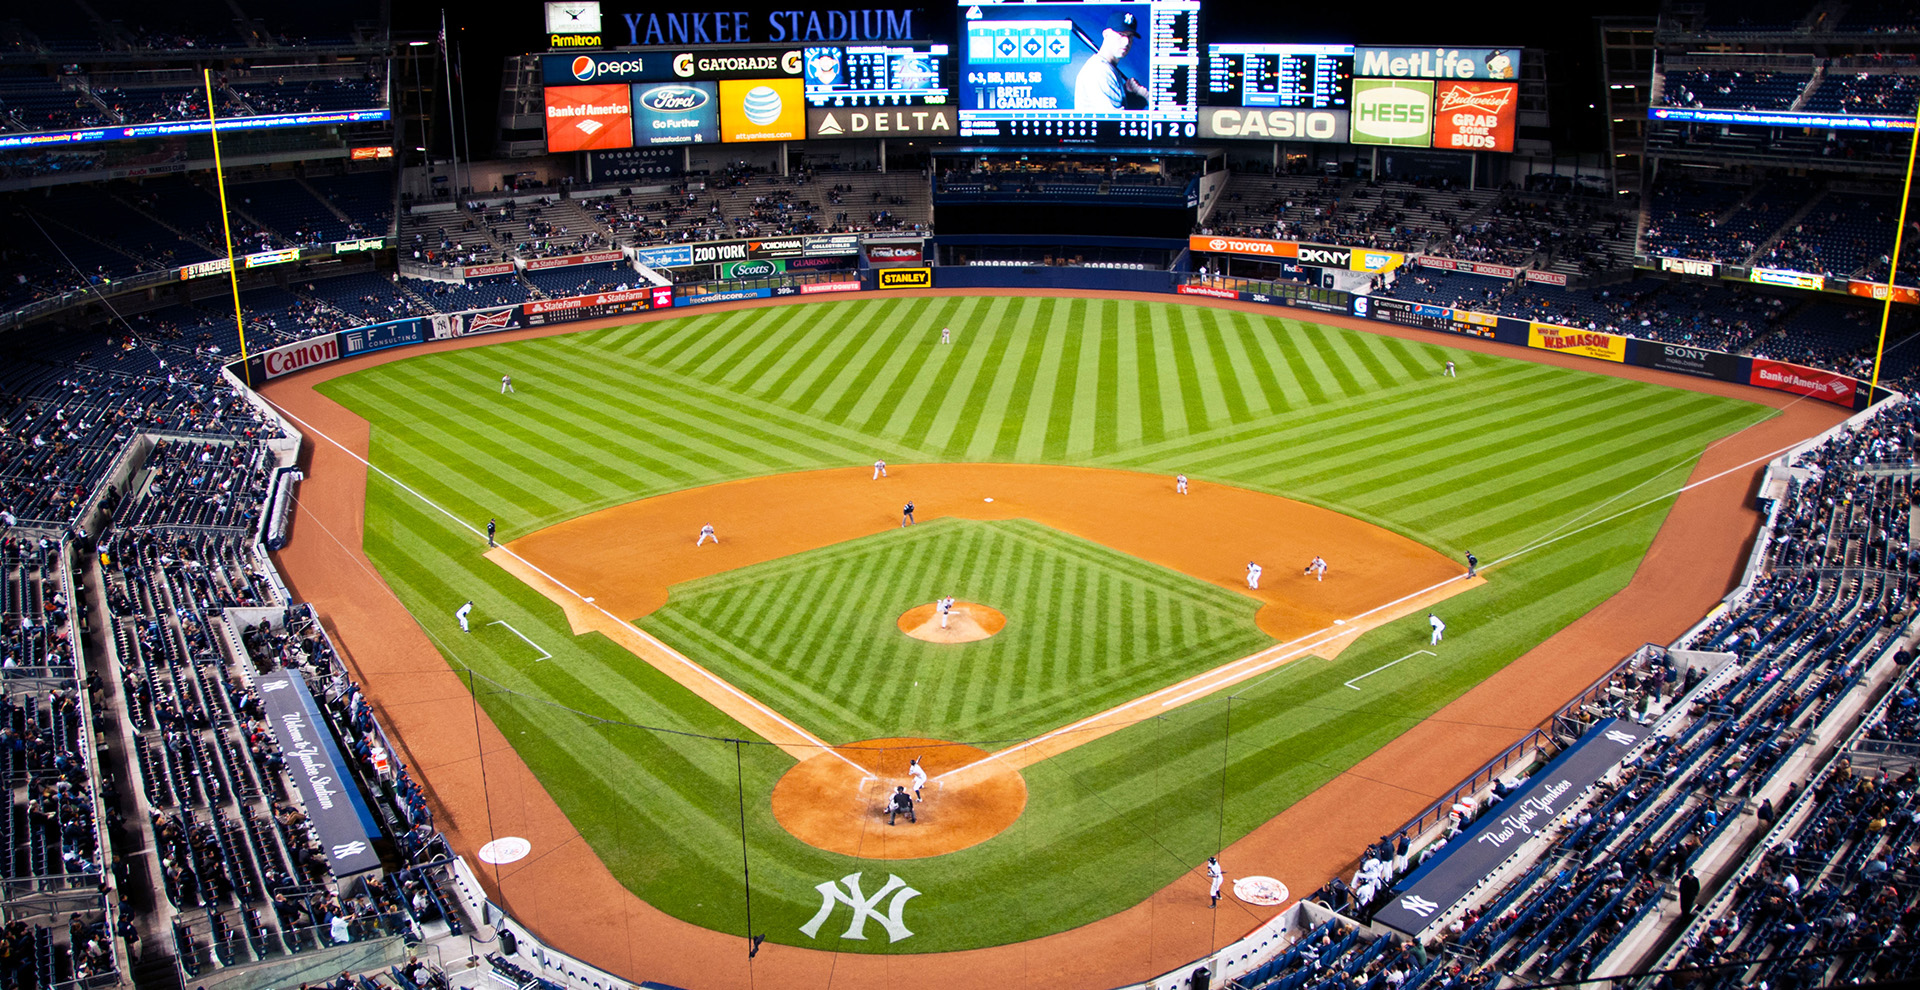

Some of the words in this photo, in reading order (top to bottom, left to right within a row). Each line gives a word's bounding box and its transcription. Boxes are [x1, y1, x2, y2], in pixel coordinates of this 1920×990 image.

[623, 12, 750, 45] YANKEE
[769, 9, 913, 42] STADIUM
[551, 33, 602, 47] Armitron
[598, 58, 643, 76] pepsi
[673, 53, 694, 77] G
[699, 57, 777, 71] GATORADE
[781, 51, 802, 74] G
[1362, 48, 1475, 78] MetLife
[653, 89, 696, 108] Ford
[975, 87, 996, 110] 11
[997, 86, 1032, 98] BRETT
[997, 97, 1057, 109] GARDNER
[1440, 92, 1509, 106] Budweiser
[548, 105, 576, 117] Bank
[574, 104, 586, 116] of
[586, 102, 628, 115] America
[1361, 103, 1425, 123] HESS
[652, 120, 666, 129] Go
[667, 118, 699, 128] Further
[851, 112, 950, 132] DELTA
[1211, 109, 1335, 138] CASIO
[1452, 114, 1498, 127] GRAB
[735, 131, 792, 140] att.yankees.com
[1154, 122, 1162, 137] 1
[1169, 122, 1179, 137] 2
[1184, 122, 1196, 137] 0
[1459, 126, 1489, 135] SOME
[1451, 134, 1496, 148] BUDS
[761, 240, 802, 250] YOKOHAMA
[1228, 241, 1274, 253] TOYOTA
[695, 247, 716, 261] ZOO
[717, 244, 746, 259] YORK
[1298, 248, 1350, 265] DKNY
[188, 260, 231, 275] SYRACUSE
[1283, 263, 1303, 272] FedEx
[1366, 255, 1386, 267] SAP
[1420, 258, 1453, 268] MODELL'S
[737, 264, 769, 276] Scotts
[1476, 266, 1511, 276] MODELL'S
[1527, 271, 1564, 283] MODELL'S
[884, 273, 926, 283] STANLEY
[808, 284, 833, 292] DUNKIN'
[690, 291, 757, 304] freecreditscore.com
[469, 315, 511, 327] Budweiser
[368, 334, 417, 348] CONSULTING
[266, 339, 338, 374] Canon
[1664, 346, 1709, 360] SONY
[1760, 369, 1783, 382] Bank
[1783, 374, 1793, 383] of
[1793, 376, 1828, 392] America
[1478, 826, 1514, 847] New
[1501, 804, 1538, 834] York
[1524, 779, 1572, 815] Yankees
[798, 871, 922, 944] NY
